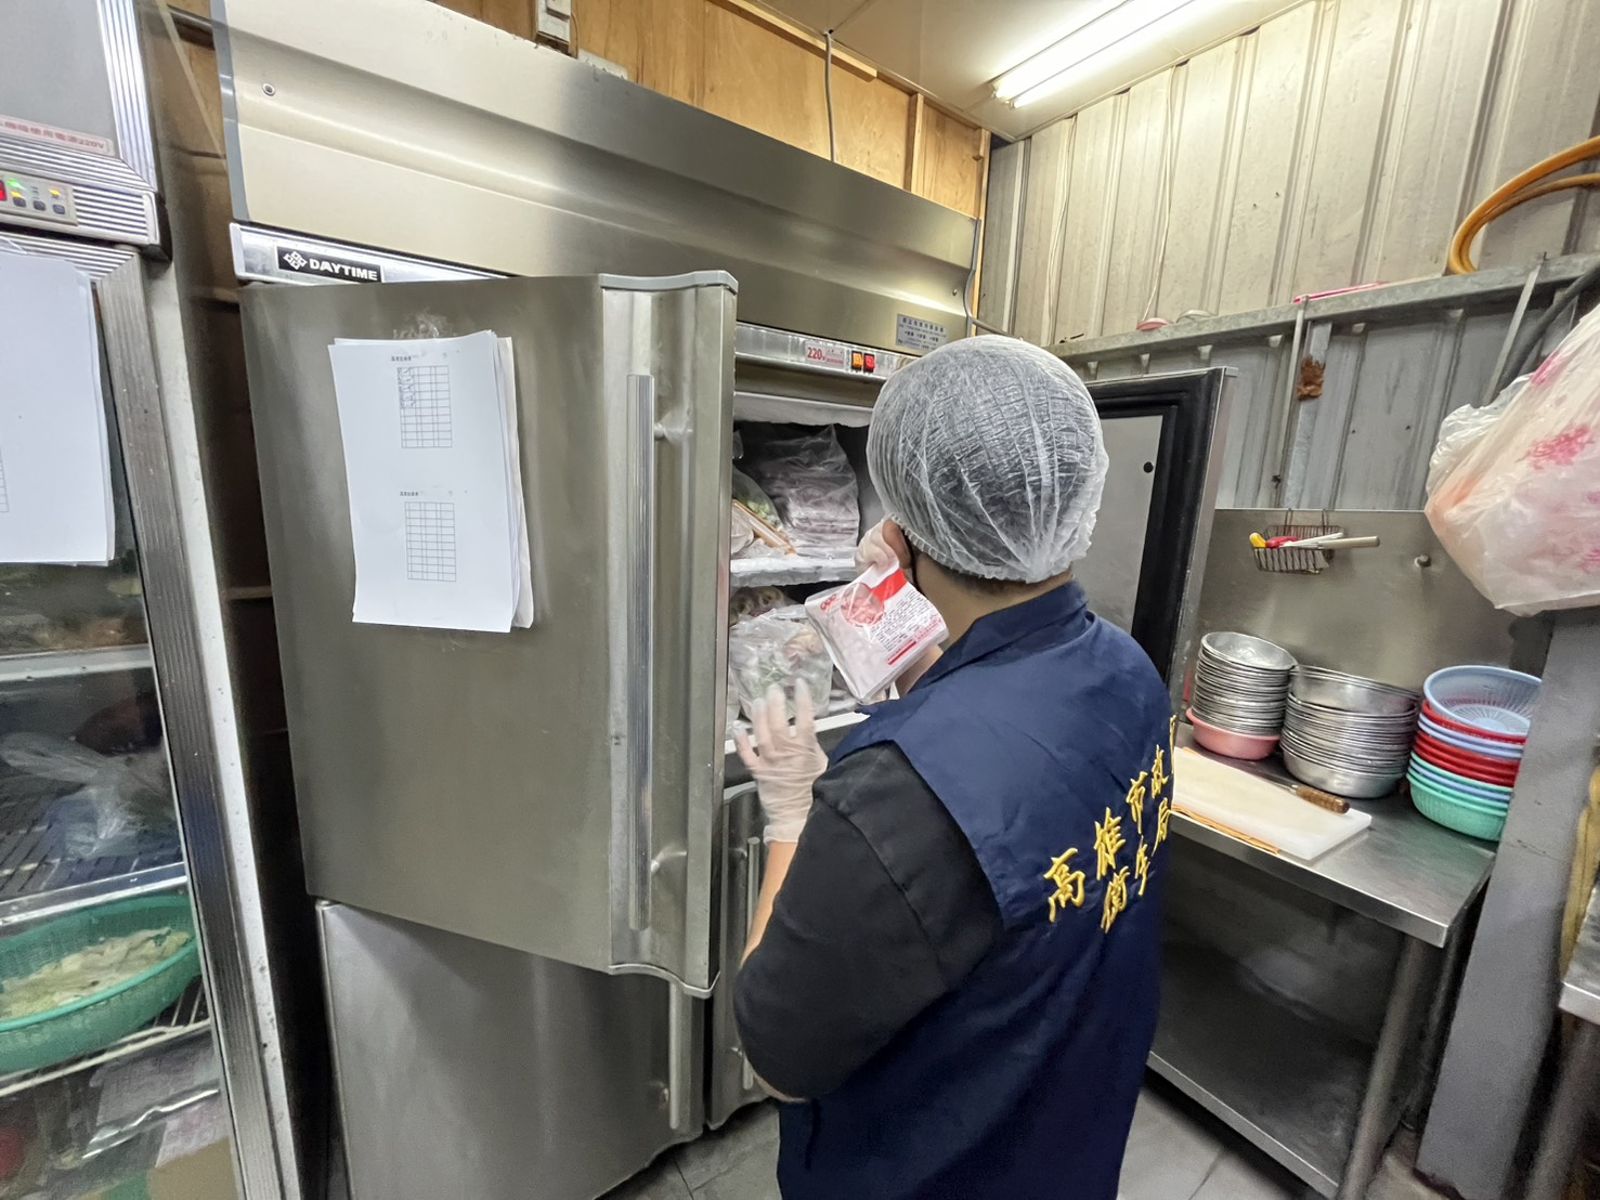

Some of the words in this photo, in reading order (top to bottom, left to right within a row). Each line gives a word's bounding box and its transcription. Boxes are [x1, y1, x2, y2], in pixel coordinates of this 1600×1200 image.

[309, 258, 378, 281] DAYTIME
[1043, 715, 1176, 923] 高雄市政
